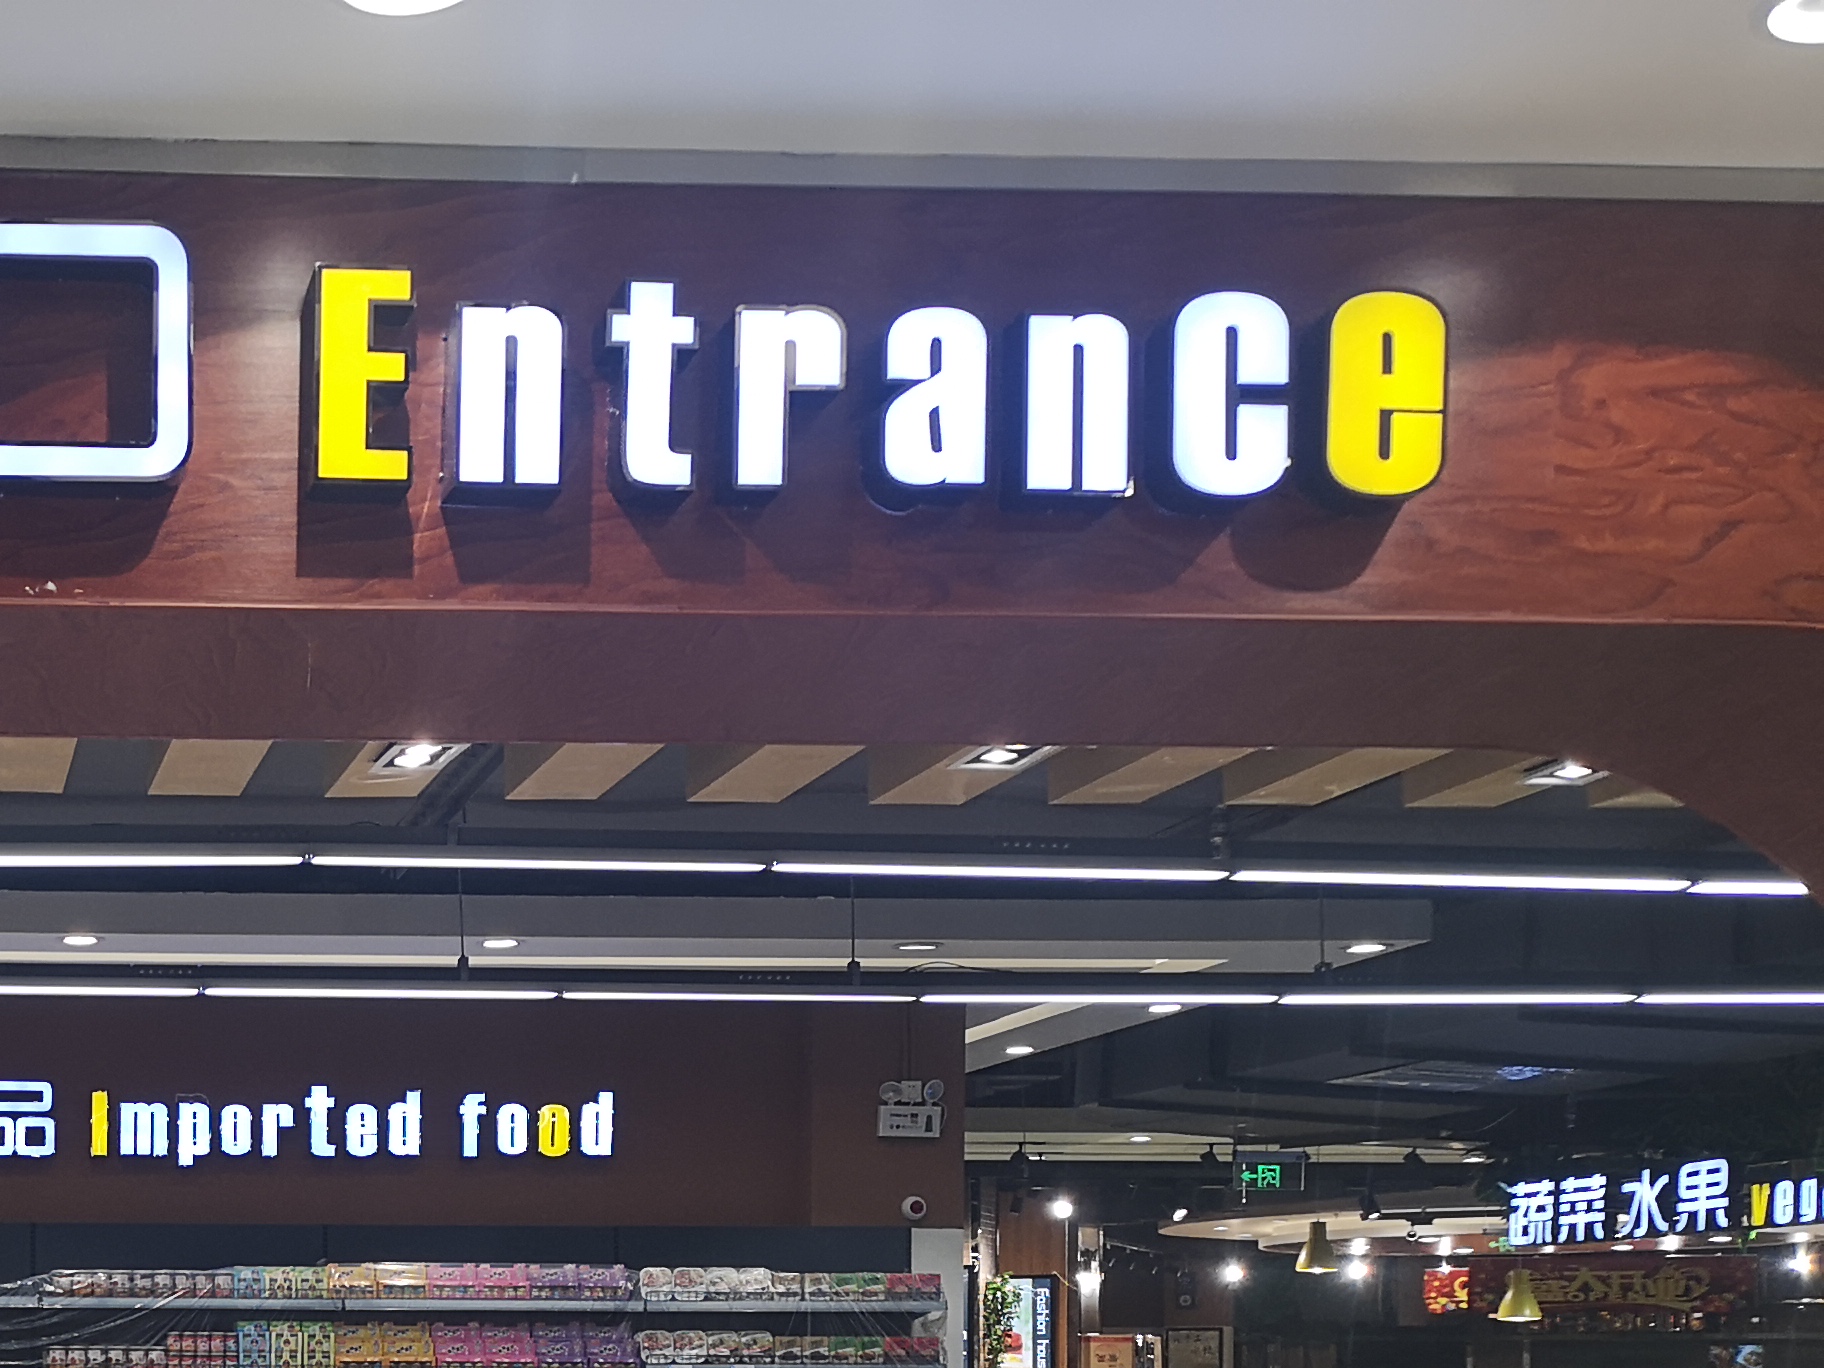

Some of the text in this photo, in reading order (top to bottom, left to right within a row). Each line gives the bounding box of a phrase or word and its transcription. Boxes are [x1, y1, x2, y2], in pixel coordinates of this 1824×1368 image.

[318, 269, 1447, 497] Entrance
[90, 1085, 614, 1167] Imported food
[1750, 1177, 1824, 1228] veg
